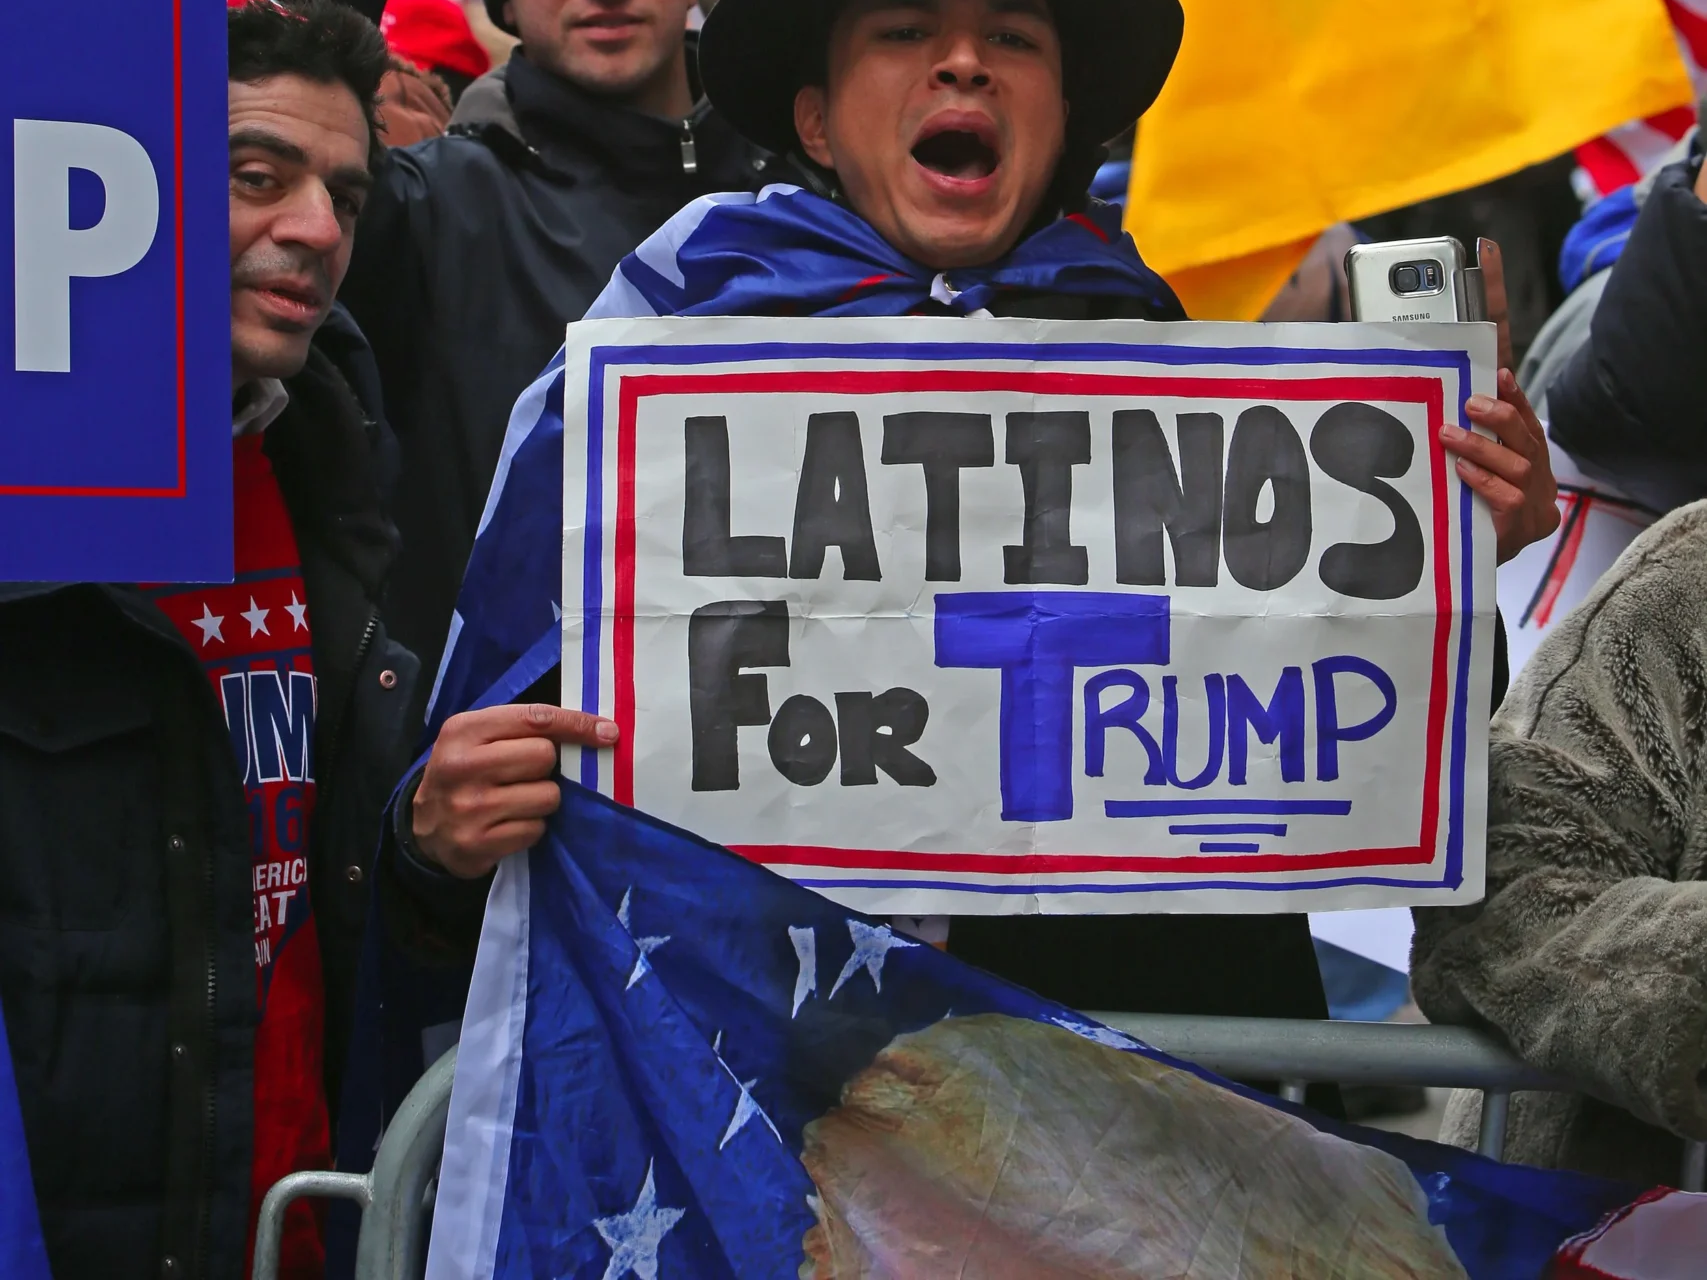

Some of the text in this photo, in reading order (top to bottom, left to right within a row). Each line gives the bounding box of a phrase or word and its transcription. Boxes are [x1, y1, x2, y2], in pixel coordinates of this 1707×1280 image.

[14, 118, 160, 373] P
[1391, 312, 1431, 322] SAMSUNG
[683, 402, 1425, 600] LATINOS
[688, 591, 1397, 822] FOR TRUMP
[252, 856, 308, 892] ERIC
